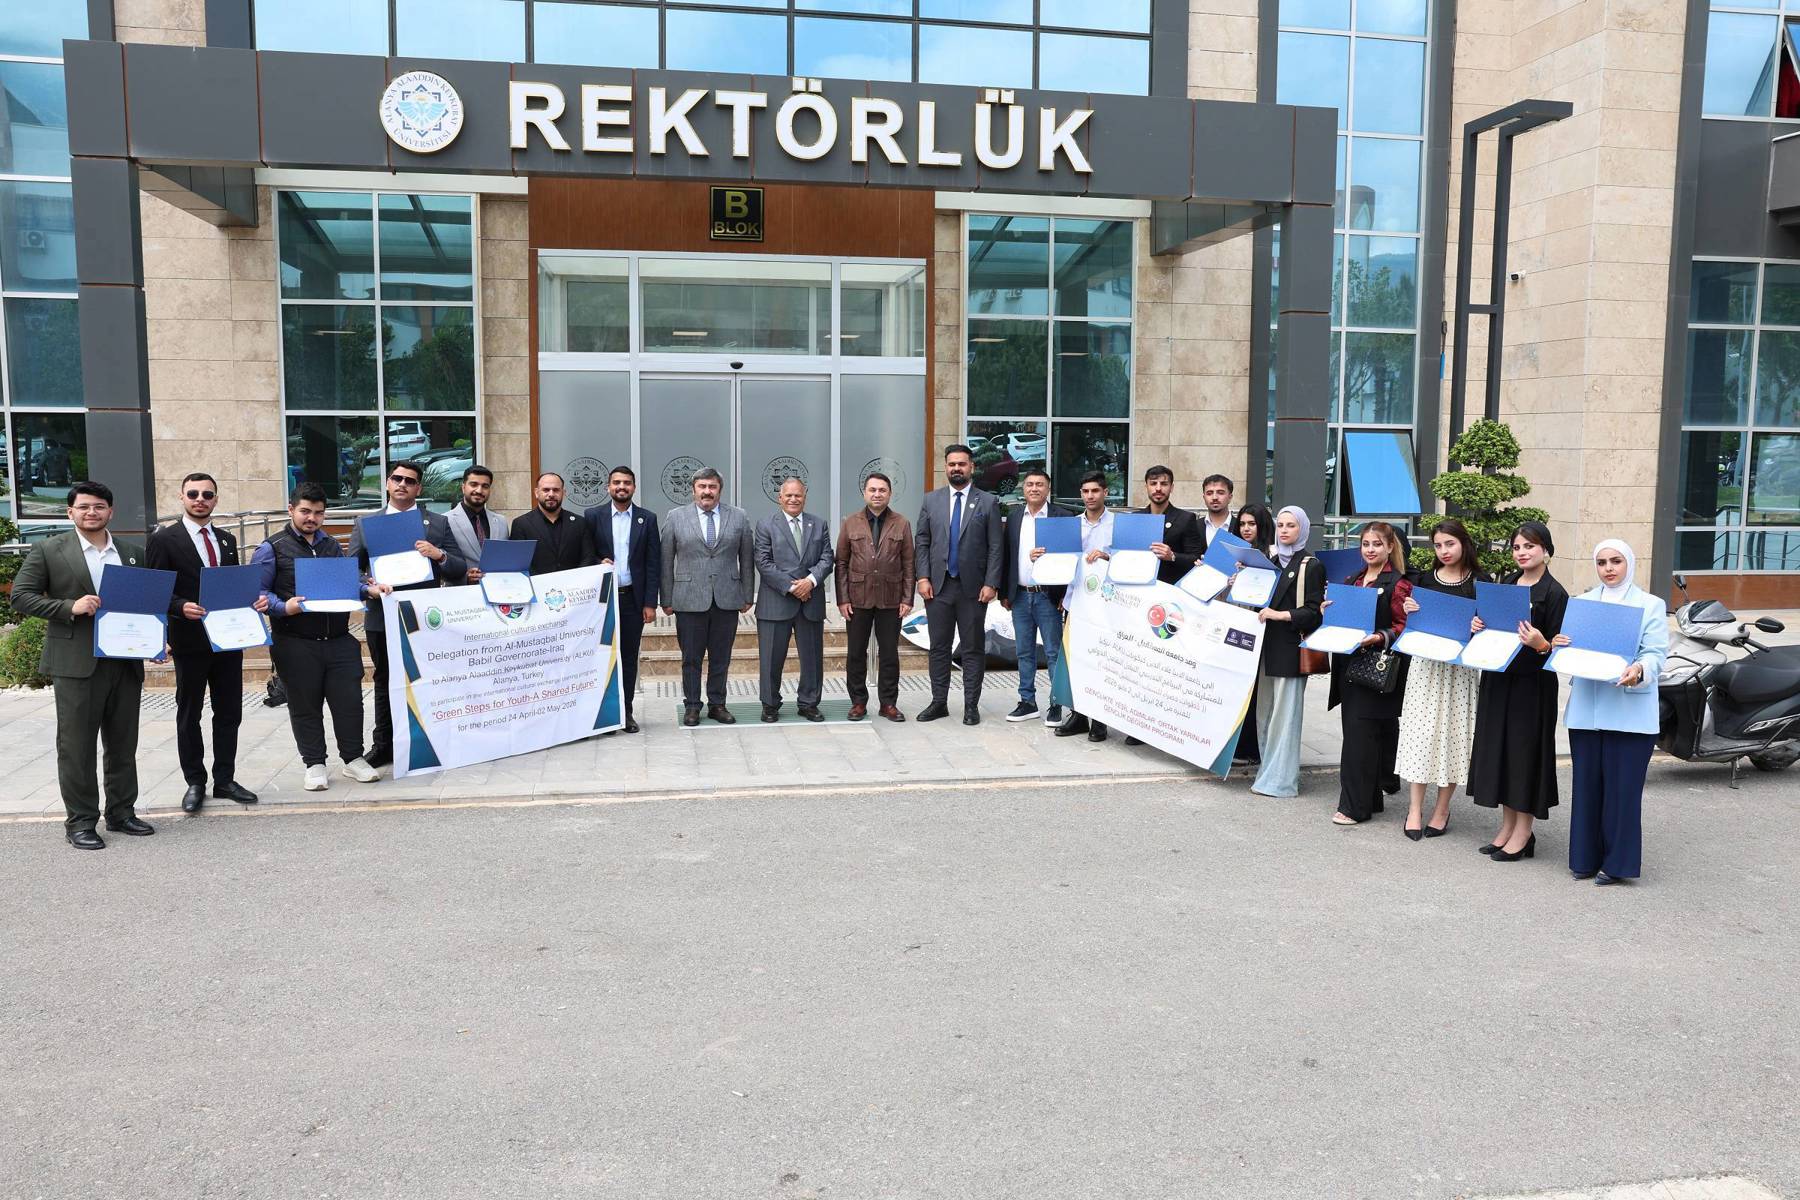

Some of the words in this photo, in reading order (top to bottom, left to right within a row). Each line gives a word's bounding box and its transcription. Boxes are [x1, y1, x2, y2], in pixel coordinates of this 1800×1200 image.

[509, 77, 1095, 173] REKTÖRLÜK
[725, 191, 749, 218] B
[714, 221, 760, 235] BLOK
[464, 628, 510, 641] International
[510, 625, 537, 636] cultural
[537, 618, 568, 631] exchange
[427, 648, 479, 662] Delegation
[481, 644, 503, 655] from
[504, 633, 558, 651] Al-Mustaqbal
[468, 656, 492, 667] Babil
[494, 644, 565, 663] Governorate-Iraq
[441, 673, 467, 684] Alanya
[469, 667, 502, 679] Alaaddin
[503, 661, 537, 674] Keykubat
[538, 654, 571, 668] University
[521, 670, 545, 681] Turkey
[1184, 659, 1197, 669] وفد
[464, 702, 491, 713] Steps
[493, 699, 505, 708] for
[507, 691, 540, 705] Youth-A
[541, 686, 570, 700] Shared
[1154, 699, 1164, 708] 24
[457, 724, 468, 732] for
[469, 721, 482, 730] the
[483, 715, 507, 728] period
[518, 707, 546, 720] April-02
[546, 705, 561, 715] May
